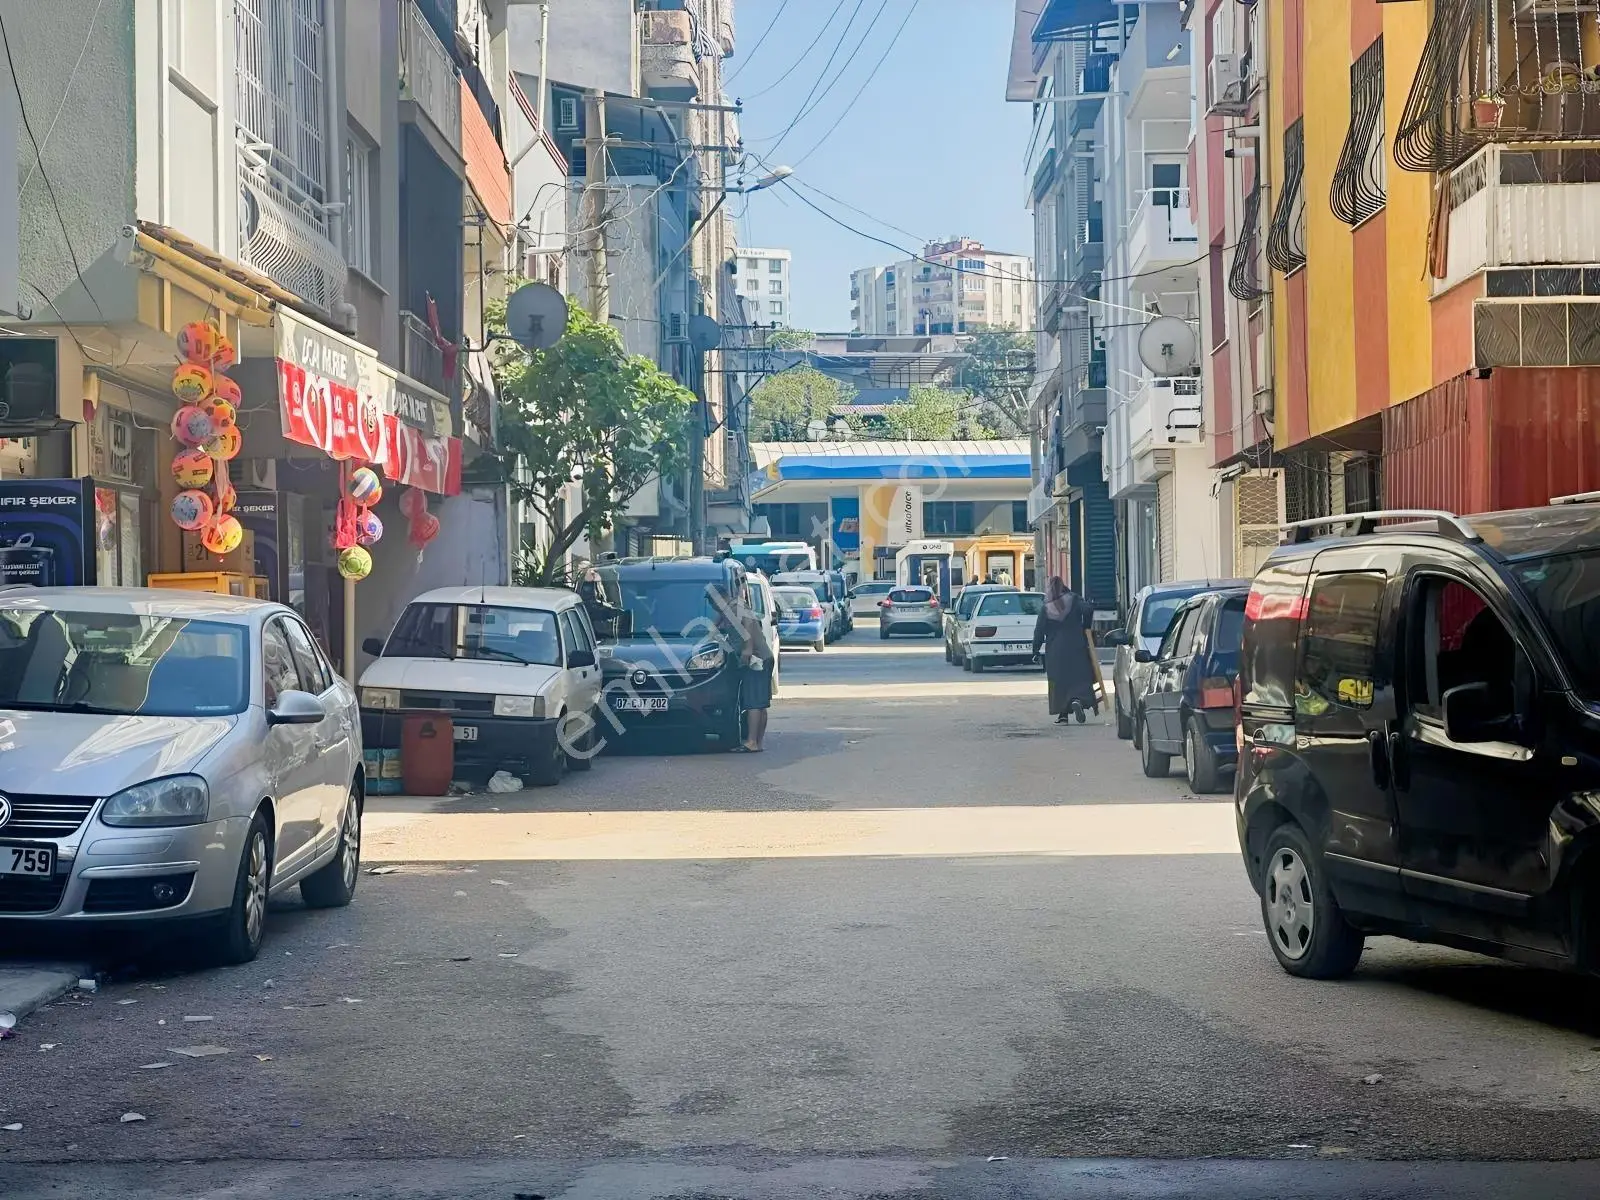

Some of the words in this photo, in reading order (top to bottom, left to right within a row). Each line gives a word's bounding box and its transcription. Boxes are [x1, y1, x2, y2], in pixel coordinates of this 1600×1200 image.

[30, 496, 76, 508] ŞEKER
[617, 698, 627, 708] 07
[651, 698, 666, 708] 202
[463, 728, 475, 738] 51
[11, 849, 50, 872] 759
